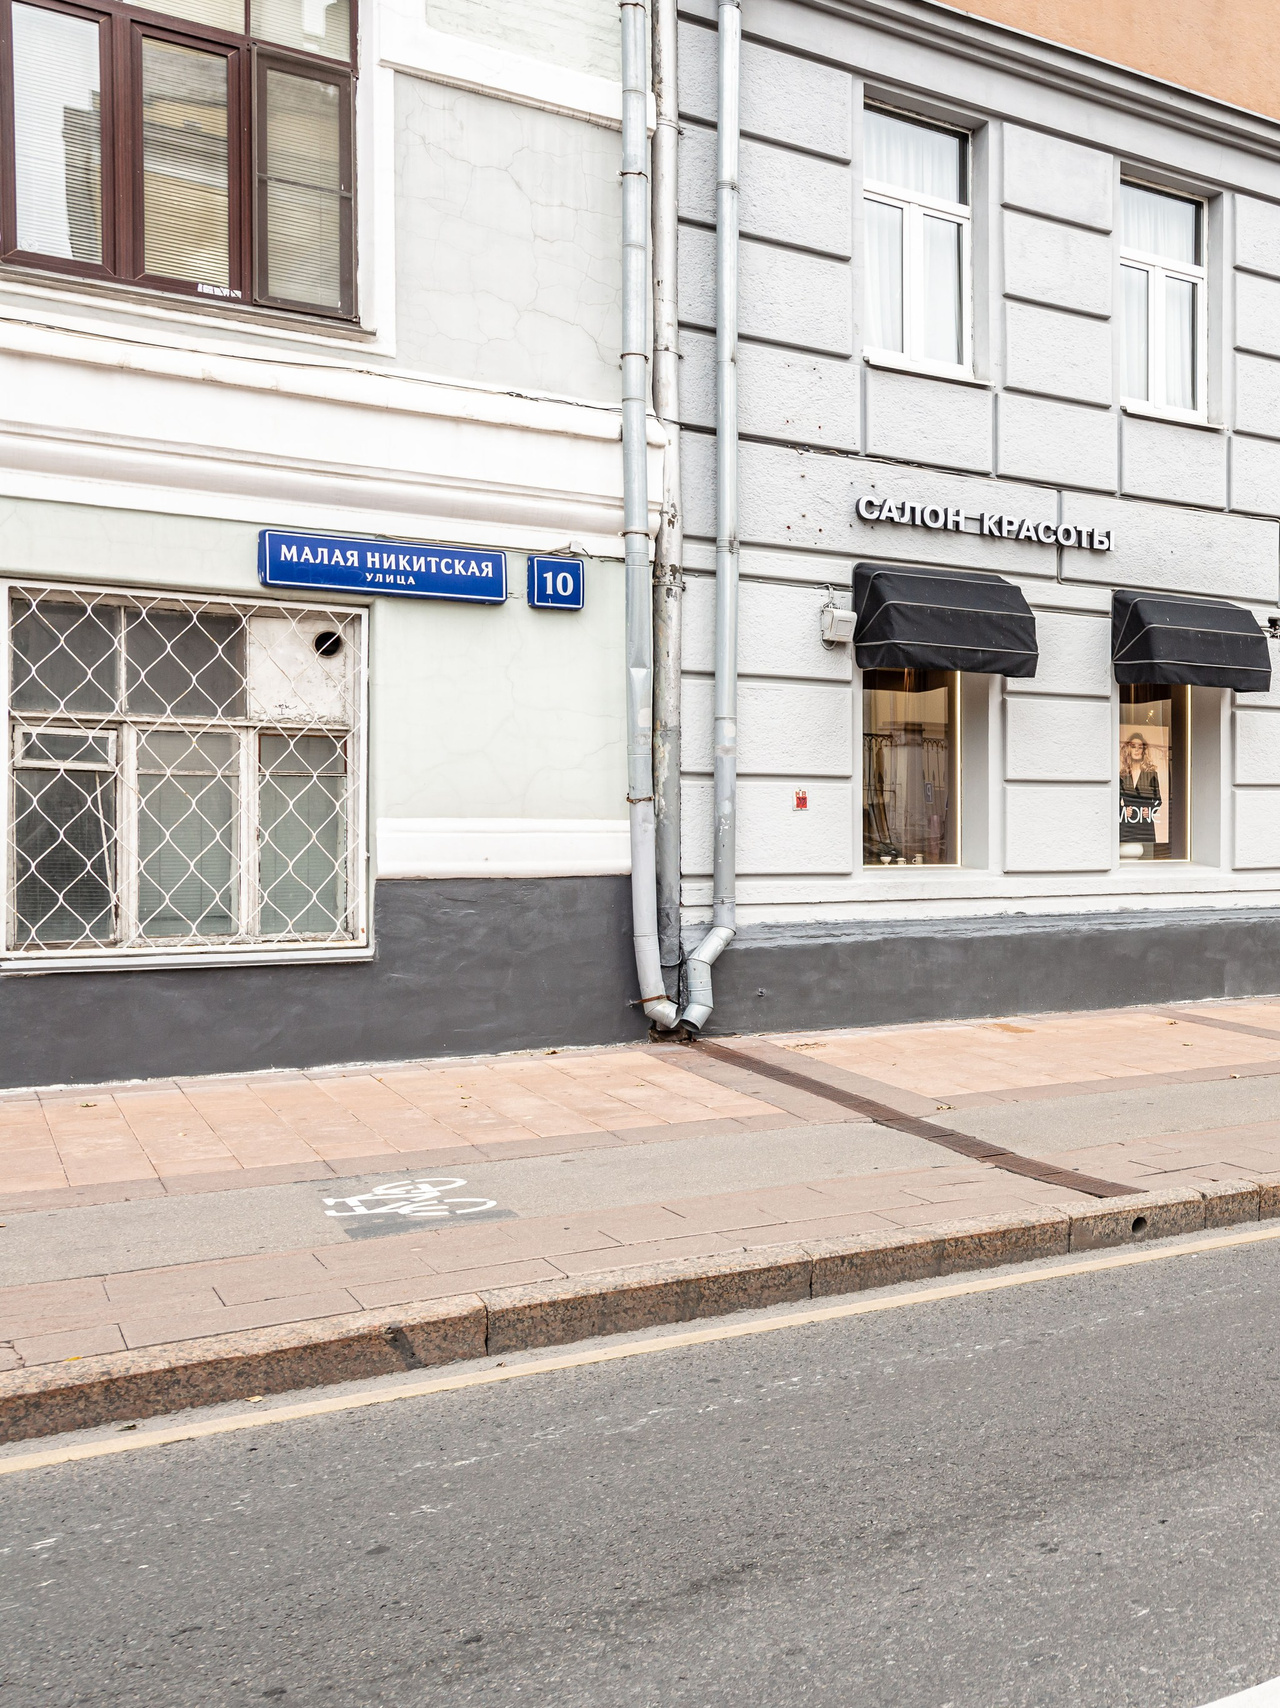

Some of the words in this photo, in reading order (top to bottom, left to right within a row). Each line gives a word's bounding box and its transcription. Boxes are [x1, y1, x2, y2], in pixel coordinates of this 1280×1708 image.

[856, 495, 966, 532] САЛОН
[980, 512, 1116, 552] КРАСОТЫ
[280, 544, 359, 567] МАЛАЯ
[366, 552, 494, 578] НИКИТСКАЯ
[365, 572, 416, 586] УЛИЦА
[543, 571, 574, 597] 10
